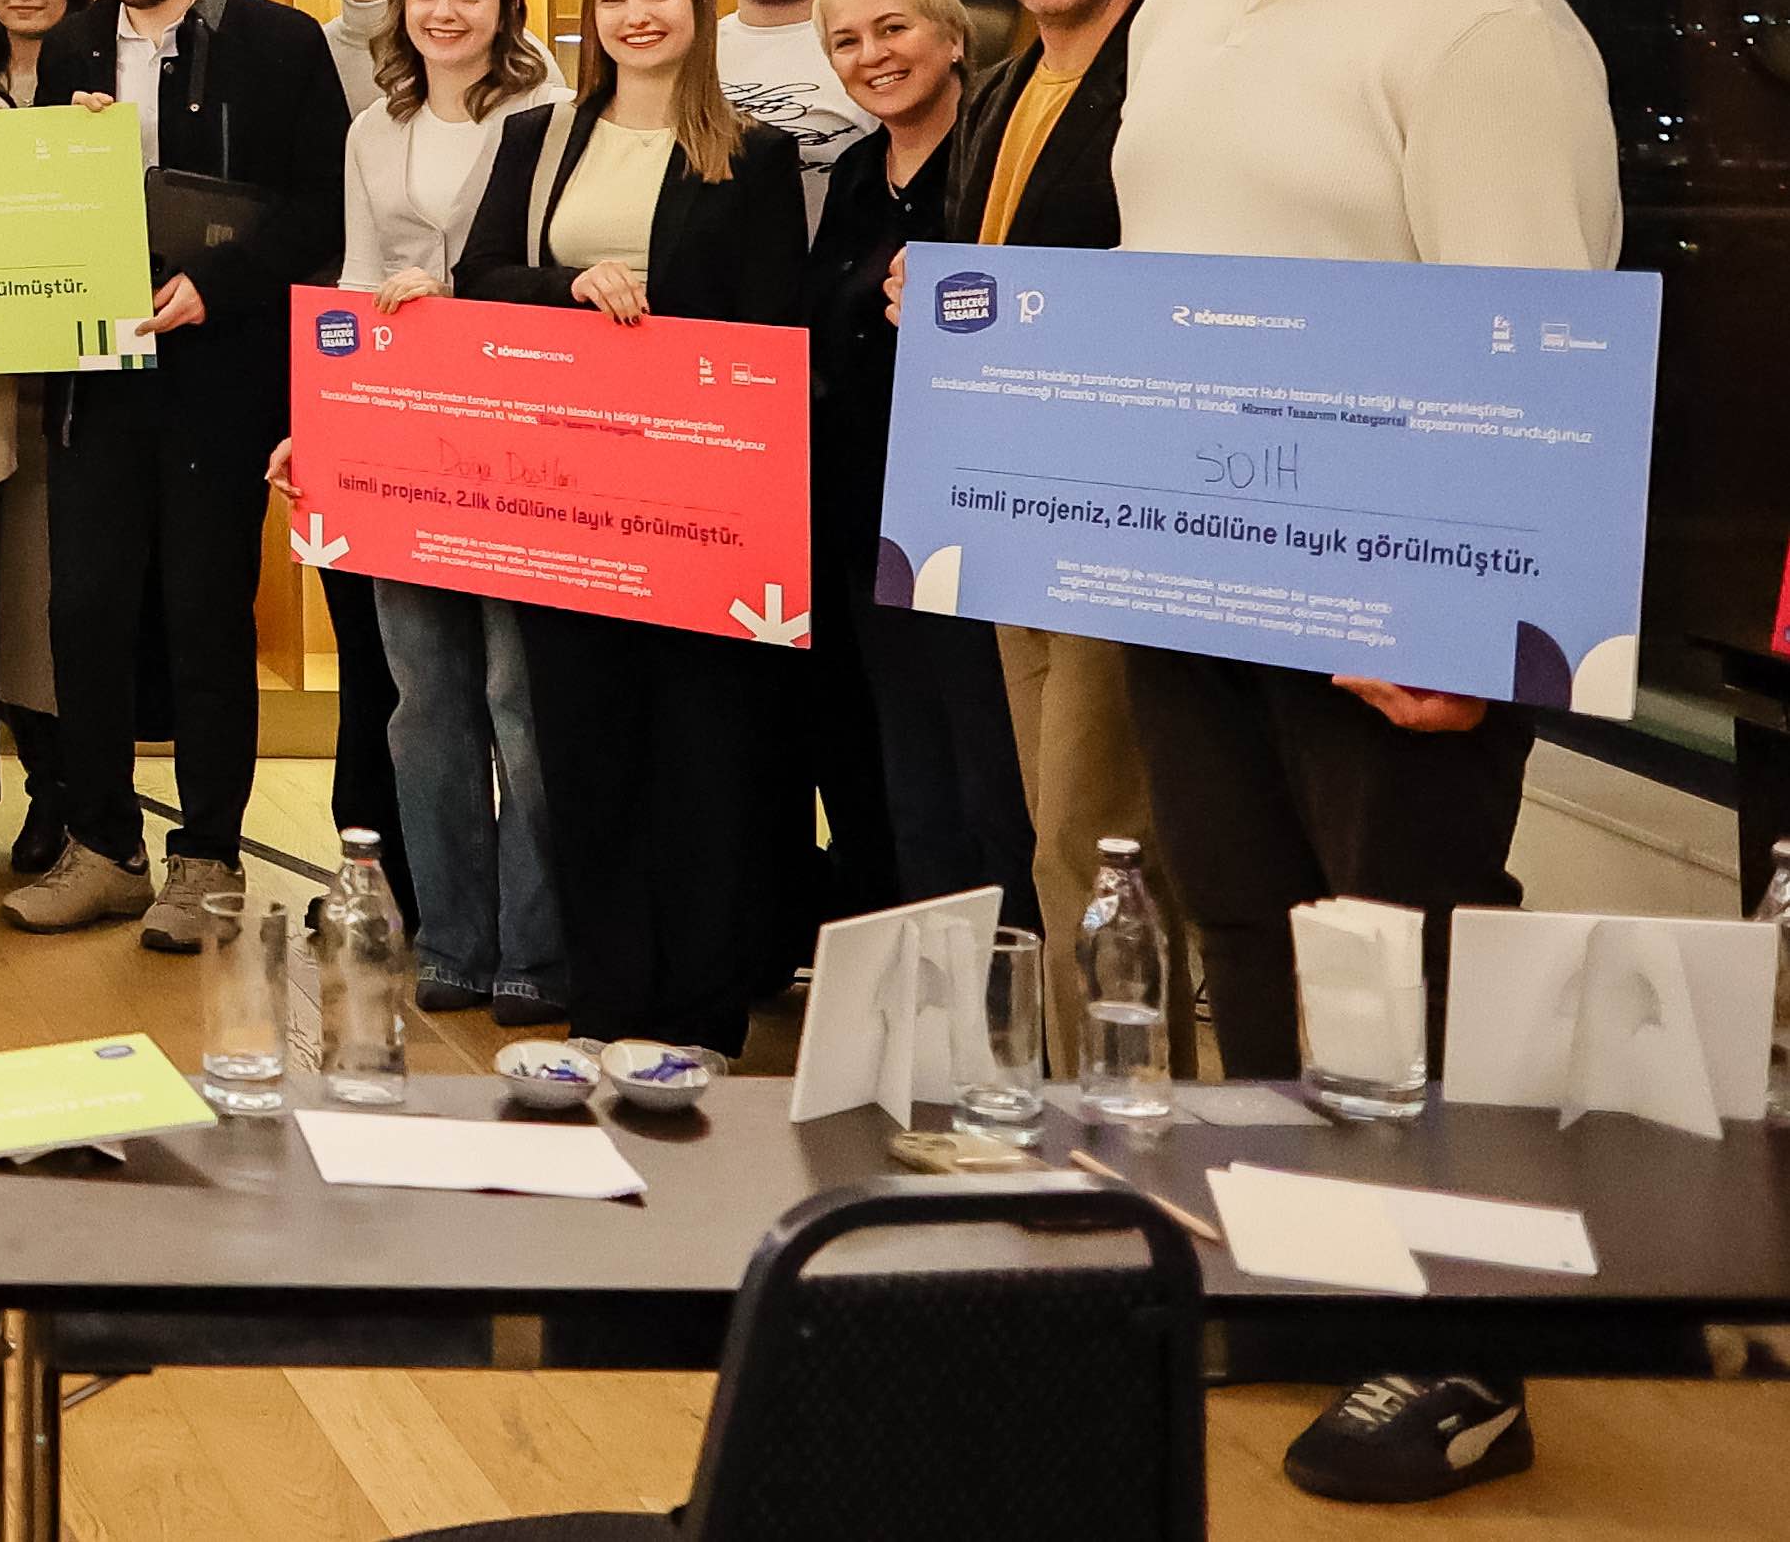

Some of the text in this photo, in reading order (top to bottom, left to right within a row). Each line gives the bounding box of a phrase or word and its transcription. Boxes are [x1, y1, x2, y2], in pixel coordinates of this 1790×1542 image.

[943, 294, 989, 310] GELECEĞİ
[943, 306, 989, 321] TASARLA
[338, 472, 378, 494] isimli
[381, 483, 452, 506] projeniz,
[496, 496, 566, 521] ödülüne
[572, 507, 613, 530] layık
[621, 515, 743, 546] görülmüştür.
[952, 485, 1539, 576] isimli projeniz, 2.lik ödülüne layık görülmüştür.
